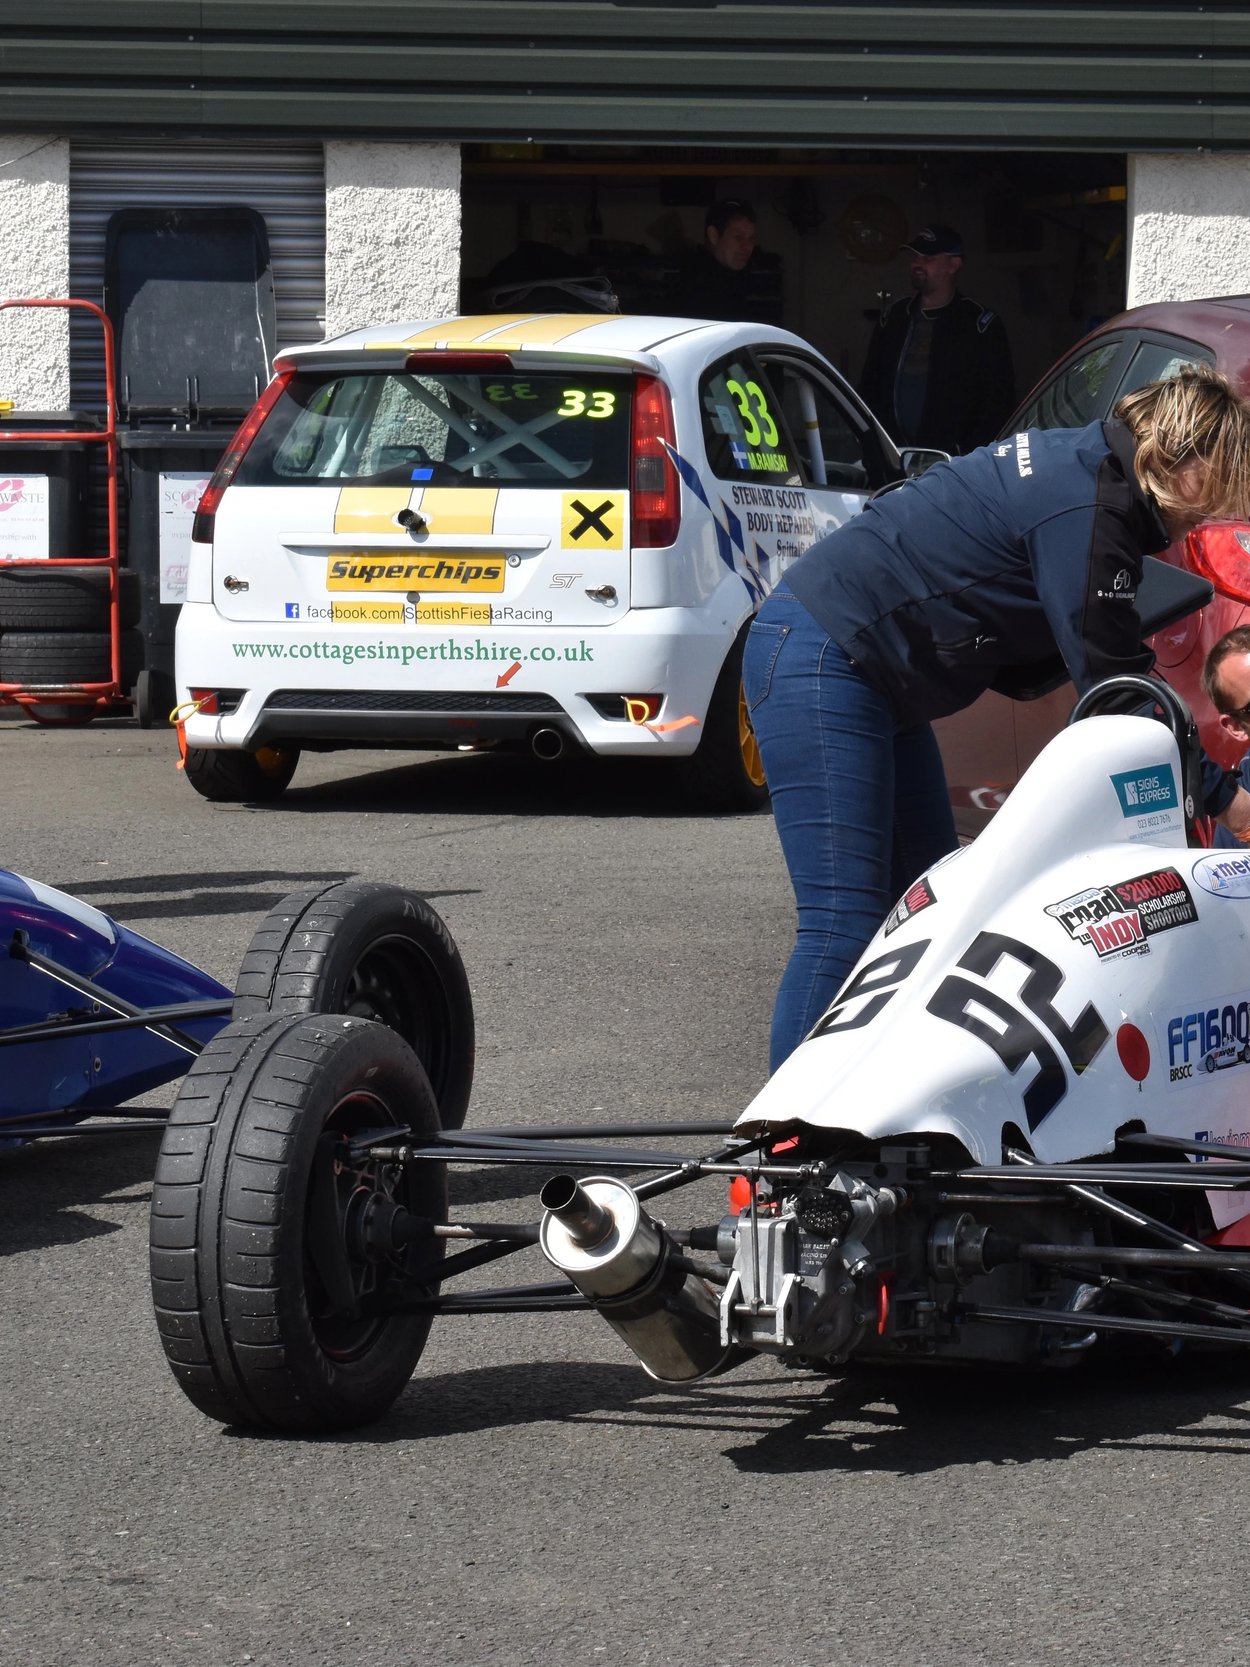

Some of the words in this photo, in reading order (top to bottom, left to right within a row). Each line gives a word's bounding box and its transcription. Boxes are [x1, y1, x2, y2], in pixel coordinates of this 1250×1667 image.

[557, 389, 616, 418] 33
[725, 379, 779, 448] 33
[747, 452, 789, 472] M.RAMSAY
[731, 485, 775, 507] STEWART
[776, 490, 806, 510] SCOTT
[746, 512, 774, 532] BODY
[776, 514, 814, 536] REPAIRS
[329, 559, 503, 584] Superchips
[548, 573, 584, 589] ST
[307, 603, 553, 623] facebook.com/ScottishFiestaRacing
[231, 638, 595, 666] www.cottagesinperthshire.co.uk
[1137, 776, 1160, 791] SIGNS
[1139, 787, 1171, 804] EXPRESS
[1116, 870, 1183, 903] $200,000
[1059, 889, 1120, 933] road
[1137, 890, 1187, 915] SCHOLARSHIP
[1144, 902, 1193, 931] SHOOTOUT
[1086, 912, 1144, 953] INDY
[1121, 943, 1150, 958] COOPER
[926, 931, 1112, 1136] 92
[1168, 1001, 1250, 1067] FF1600
[1169, 1064, 1193, 1082] BRSCC
